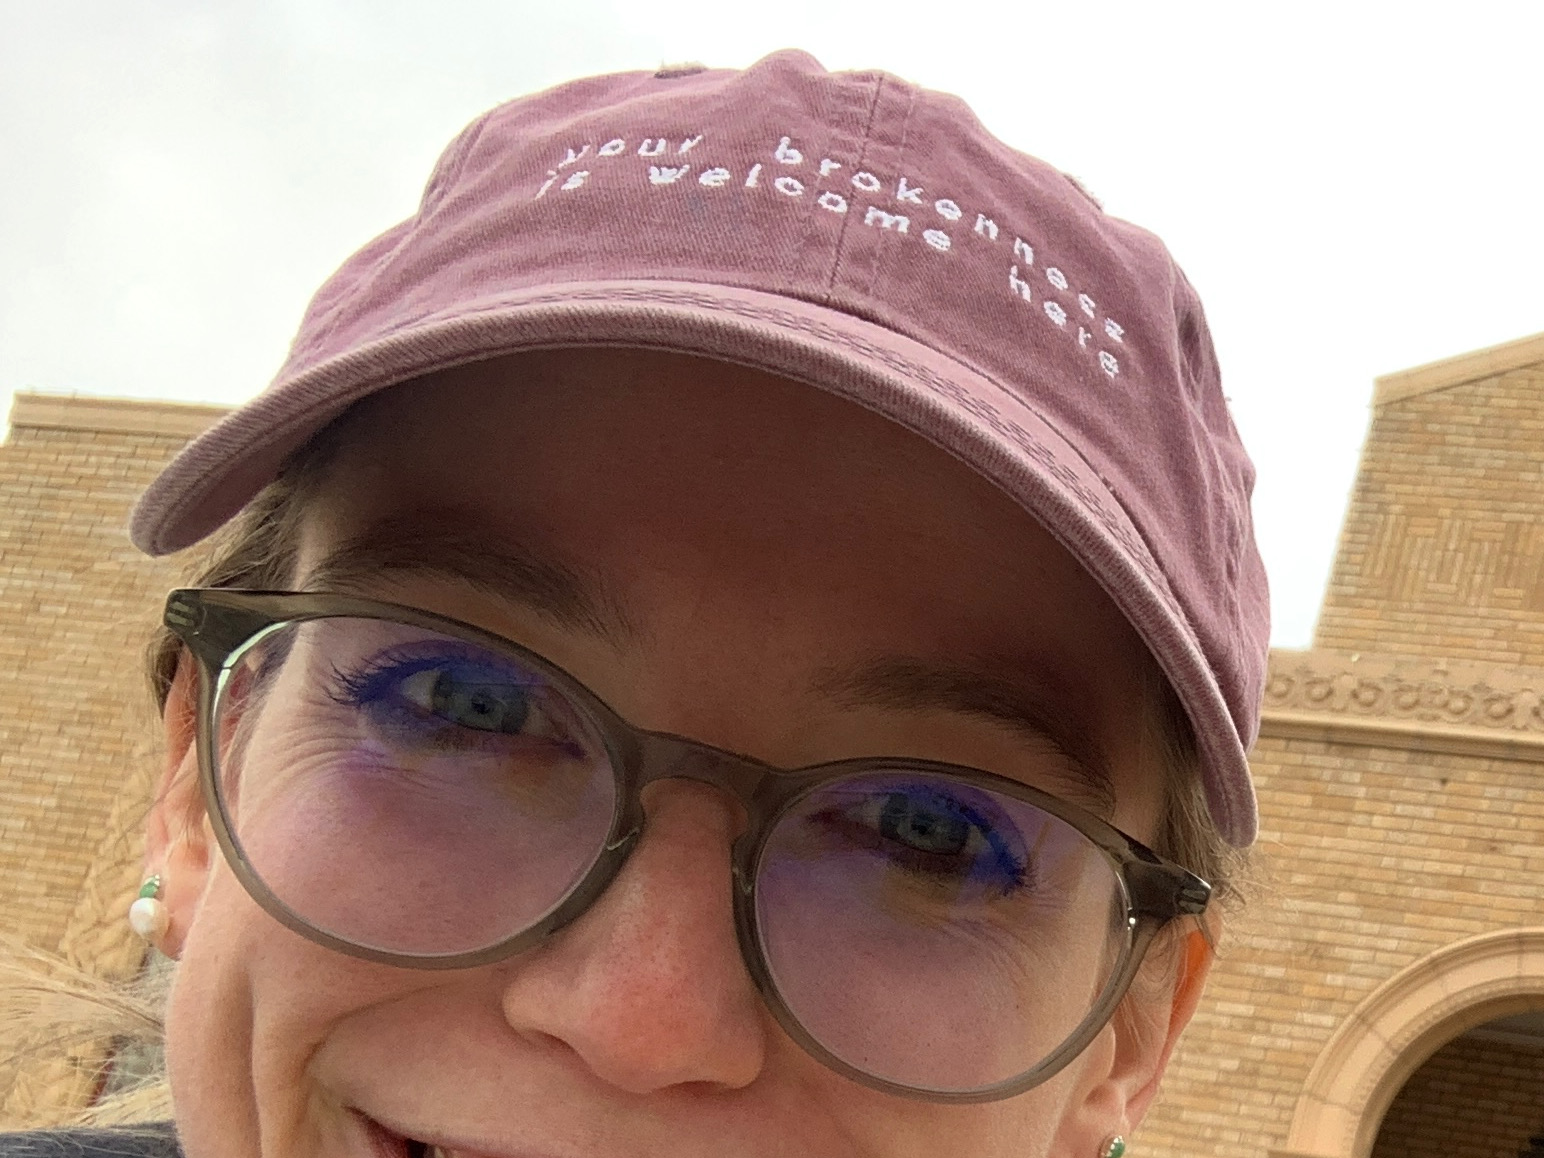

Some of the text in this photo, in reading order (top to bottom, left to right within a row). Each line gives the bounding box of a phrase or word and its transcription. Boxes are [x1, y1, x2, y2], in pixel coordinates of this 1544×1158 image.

[535, 163, 1120, 379] is welcome here
[557, 134, 1125, 343] your brokenness
